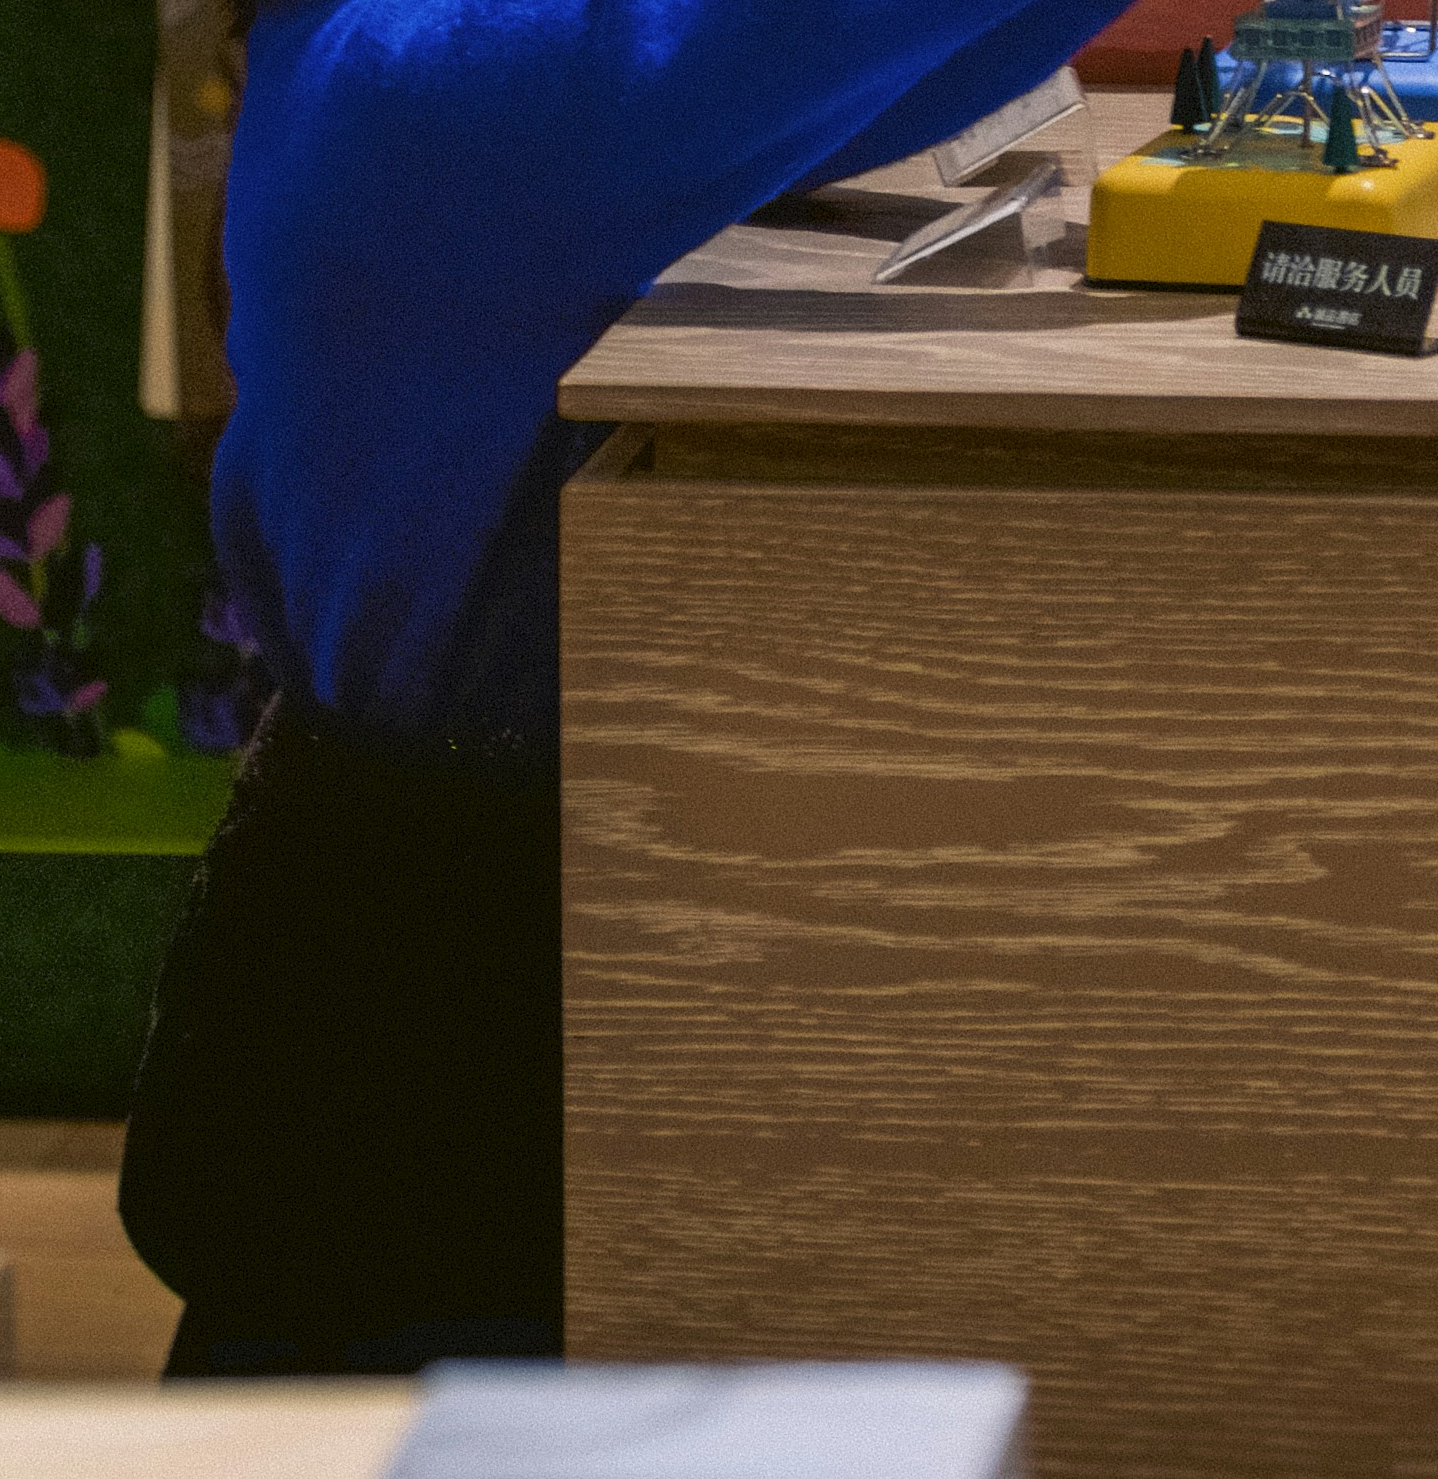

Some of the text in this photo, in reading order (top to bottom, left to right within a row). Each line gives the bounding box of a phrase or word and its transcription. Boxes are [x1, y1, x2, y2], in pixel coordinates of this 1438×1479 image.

[1261, 251, 1423, 301] 请洽服务人员
